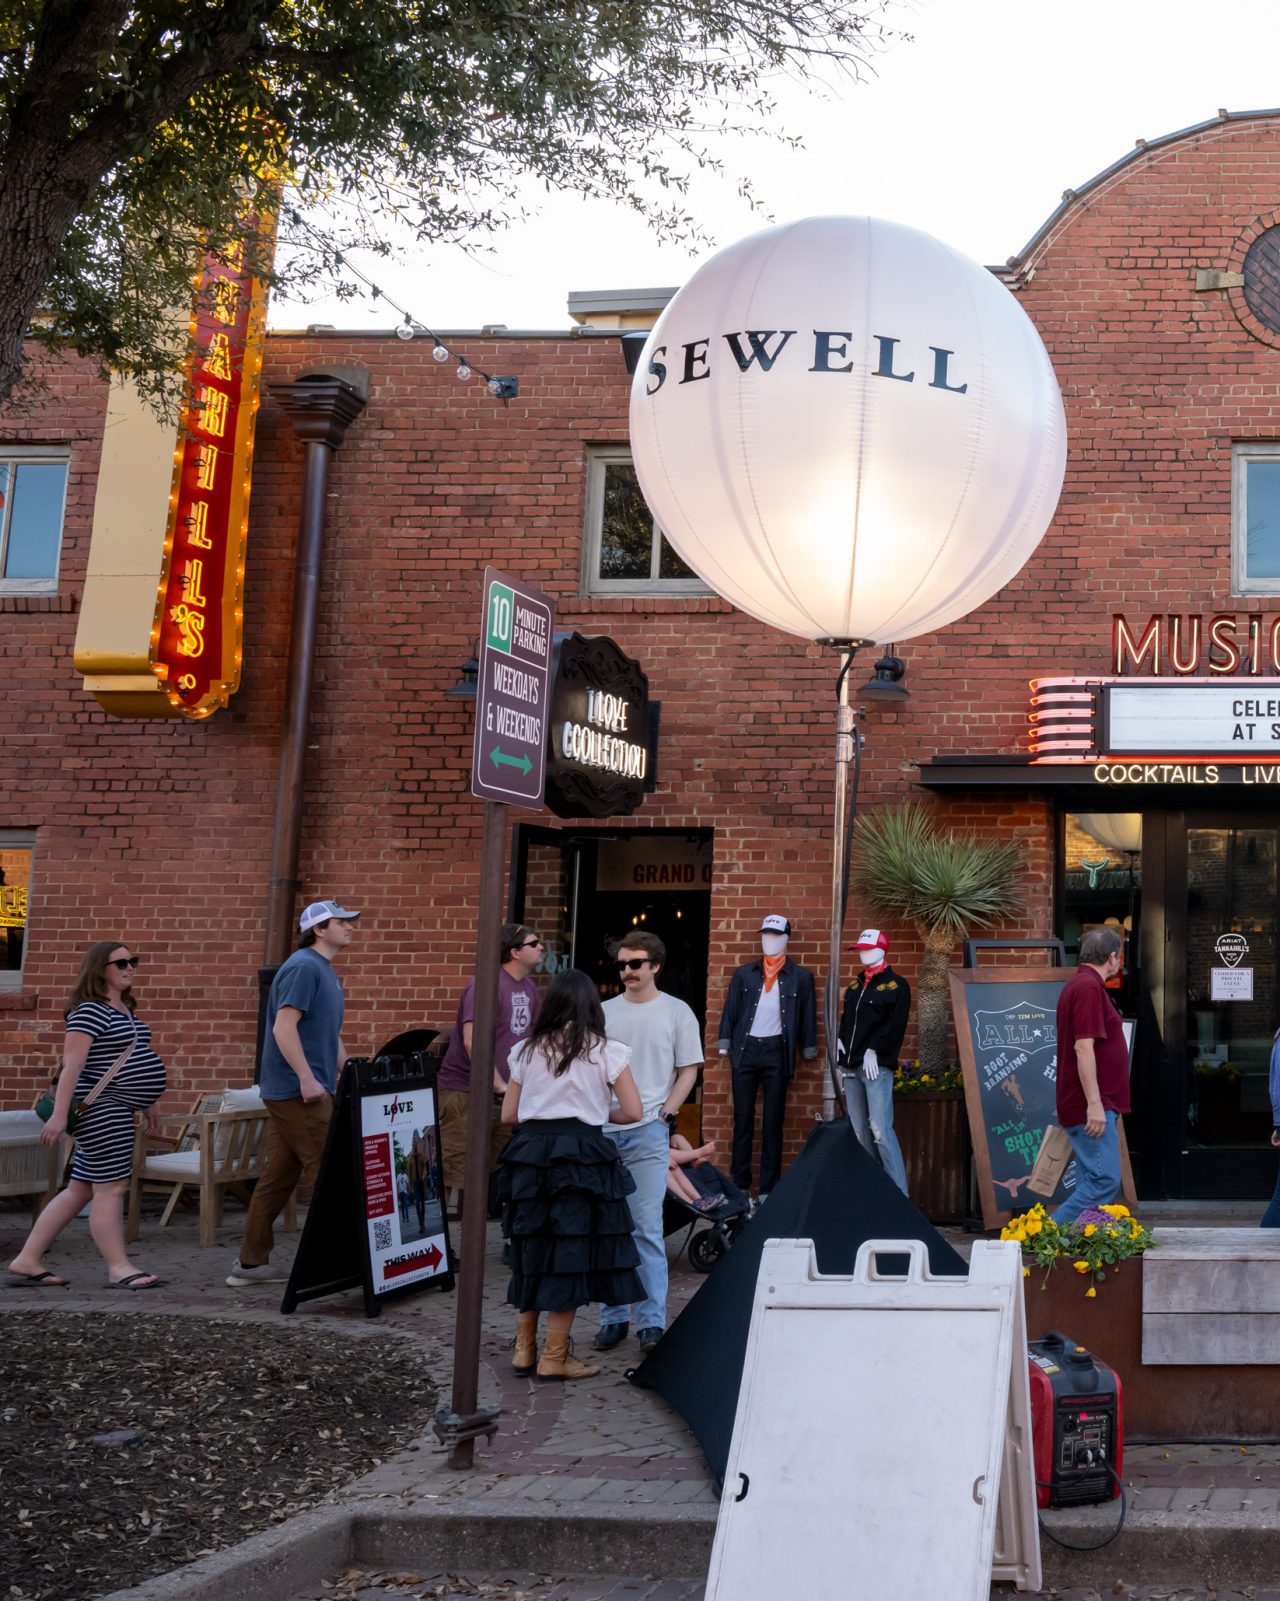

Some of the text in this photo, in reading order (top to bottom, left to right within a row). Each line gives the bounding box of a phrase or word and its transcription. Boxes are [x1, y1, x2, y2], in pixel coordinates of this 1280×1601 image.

[646, 328, 969, 396] SEWELL
[491, 594, 511, 641] 10
[515, 605, 547, 635] MINUTE
[513, 627, 547, 657] PARKING
[493, 661, 539, 705] WEEKDAYS
[486, 702, 540, 746] & WEEKENDS
[1232, 723, 1256, 741] AT
[563, 721, 647, 780] COLLECTION
[1094, 765, 1220, 784] COCKTAILS
[633, 864, 695, 883] GRAND
[983, 1052, 1009, 1076] BOOT
[983, 1052, 1028, 1092] BRANDING
[383, 1100, 414, 1116] LOVE
[1004, 1128, 1043, 1153] SHOT
[383, 1247, 432, 1268] THIS WAY
